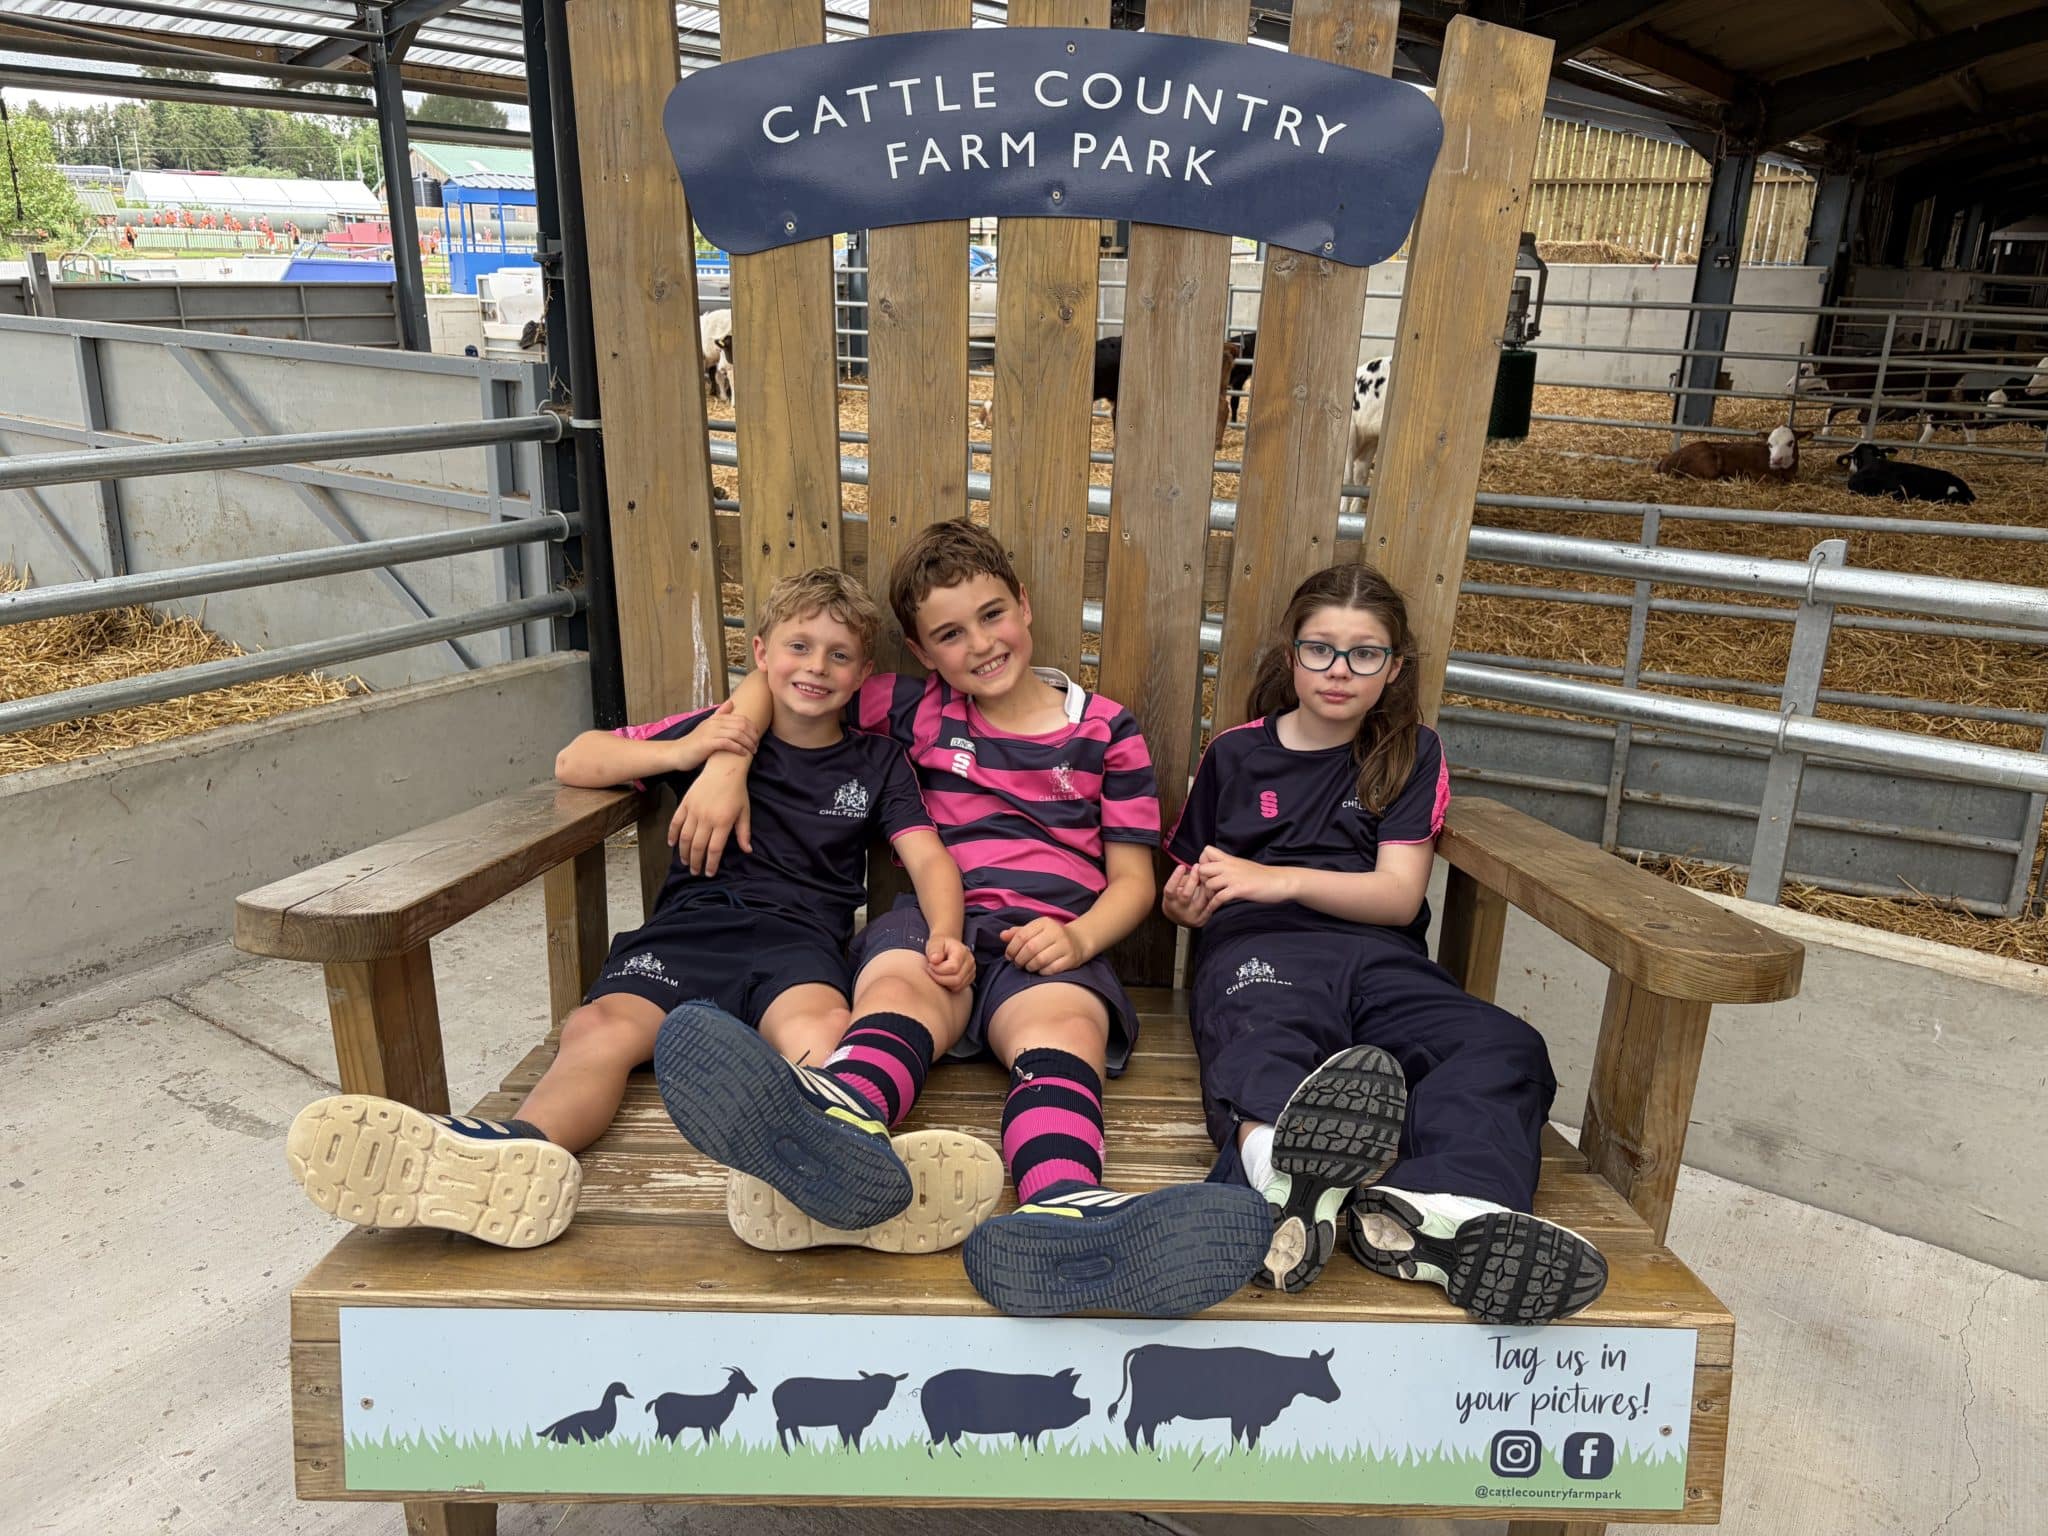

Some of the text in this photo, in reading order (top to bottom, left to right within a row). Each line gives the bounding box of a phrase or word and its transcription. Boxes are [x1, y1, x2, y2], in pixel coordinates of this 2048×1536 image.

[763, 70, 1347, 154] CATTLE COUNTRY
[886, 131, 1216, 186] FARM PARK
[1487, 1335, 1628, 1386] Tag us in
[1456, 1382, 1652, 1426] your pictures!
[1474, 1485, 1622, 1501] @cattlecountryfarmpark
